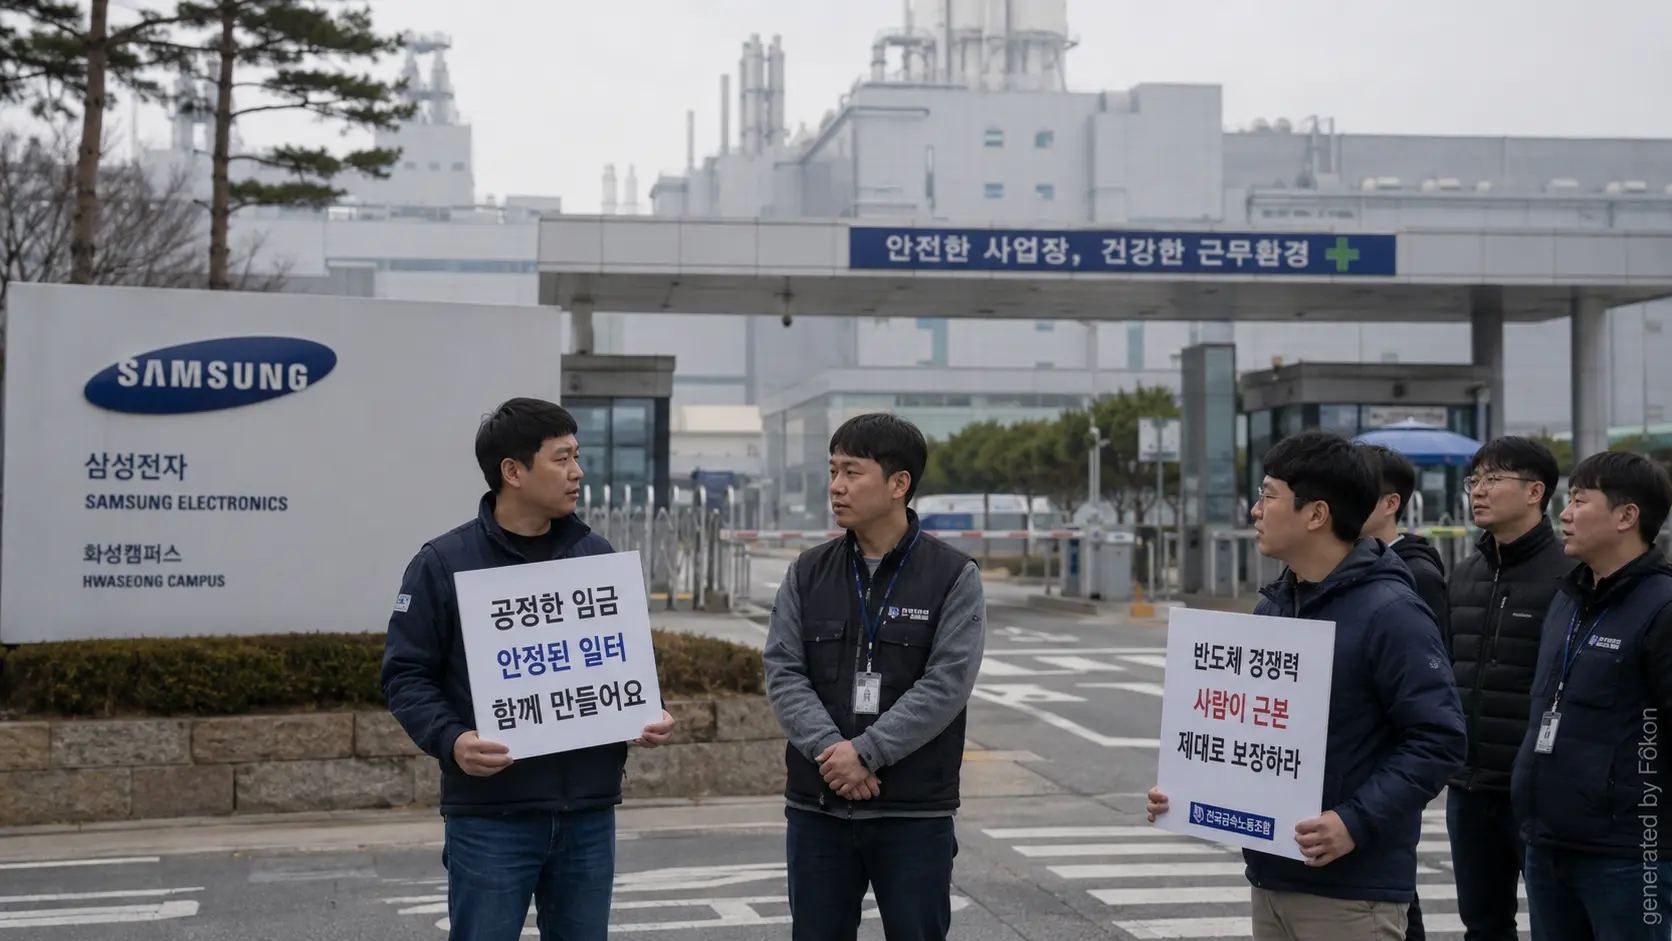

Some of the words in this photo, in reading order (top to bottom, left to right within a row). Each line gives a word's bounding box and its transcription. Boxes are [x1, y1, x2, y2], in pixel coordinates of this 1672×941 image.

[886, 235, 970, 262] 안전한
[984, 236, 1080, 265] 사업장,
[1102, 238, 1185, 265] 건강한
[1198, 240, 1308, 267] 근무환경
[117, 357, 309, 391] SAMSUNG
[85, 453, 187, 481] 삼성전자
[86, 494, 172, 510] SAMSUNG
[178, 496, 287, 511] ELECTRONICS
[83, 544, 181, 564] 화성캠퍼스
[83, 575, 163, 588] HWASEONG
[168, 575, 225, 587] CAMPUS
[491, 592, 563, 630] 공정한
[573, 586, 618, 619] 임금
[497, 640, 571, 679] 안정된
[579, 633, 626, 667] 일터
[1195, 643, 1242, 675] 반도체
[1249, 649, 1299, 682] 경쟁력
[492, 694, 542, 730] 함께
[551, 680, 646, 720] 만들어요
[1194, 688, 1245, 723] 사람이
[1253, 696, 1288, 729] 근본
[1178, 731, 1225, 762] 제대로
[1231, 741, 1301, 779] 보장하라
